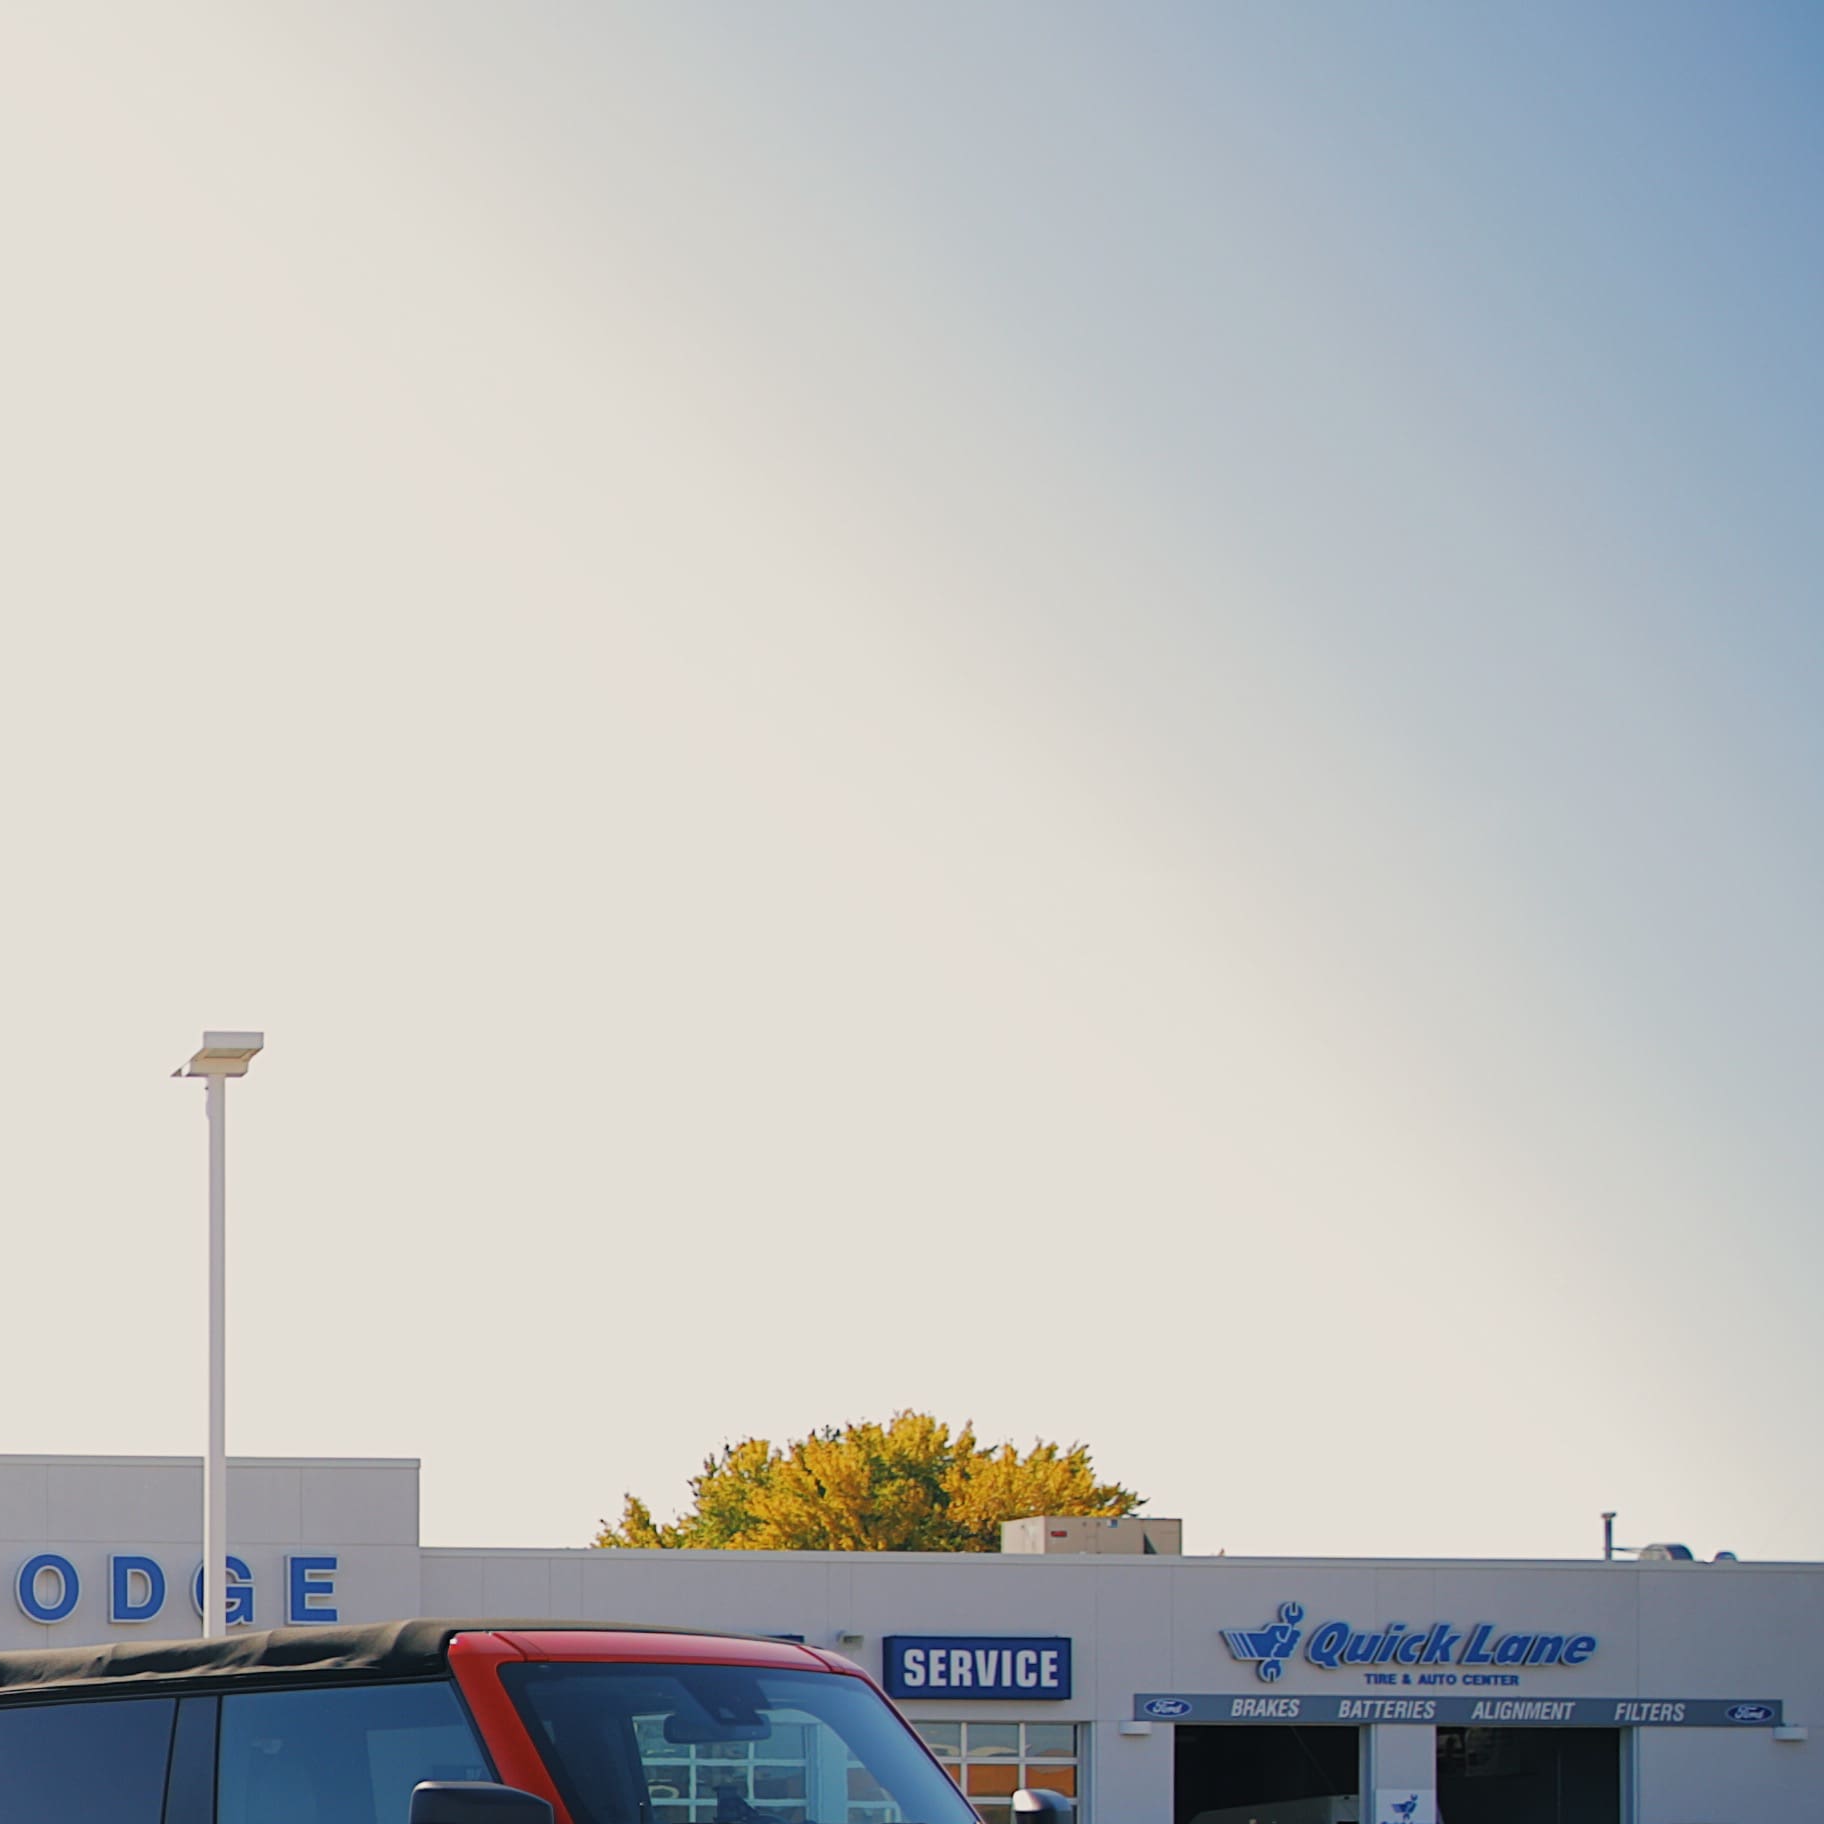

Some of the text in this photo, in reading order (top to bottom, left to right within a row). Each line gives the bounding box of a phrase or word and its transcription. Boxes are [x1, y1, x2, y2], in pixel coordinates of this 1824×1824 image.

[1305, 1620, 1597, 1669] Quick Lane
[903, 1648, 1059, 1688] SERVICE
[1364, 1672, 1520, 1687] TIRE & AUTO CENTER
[1231, 1698, 1686, 1722] BRAKES BATTERIES ALIGNMENT FILTERS
